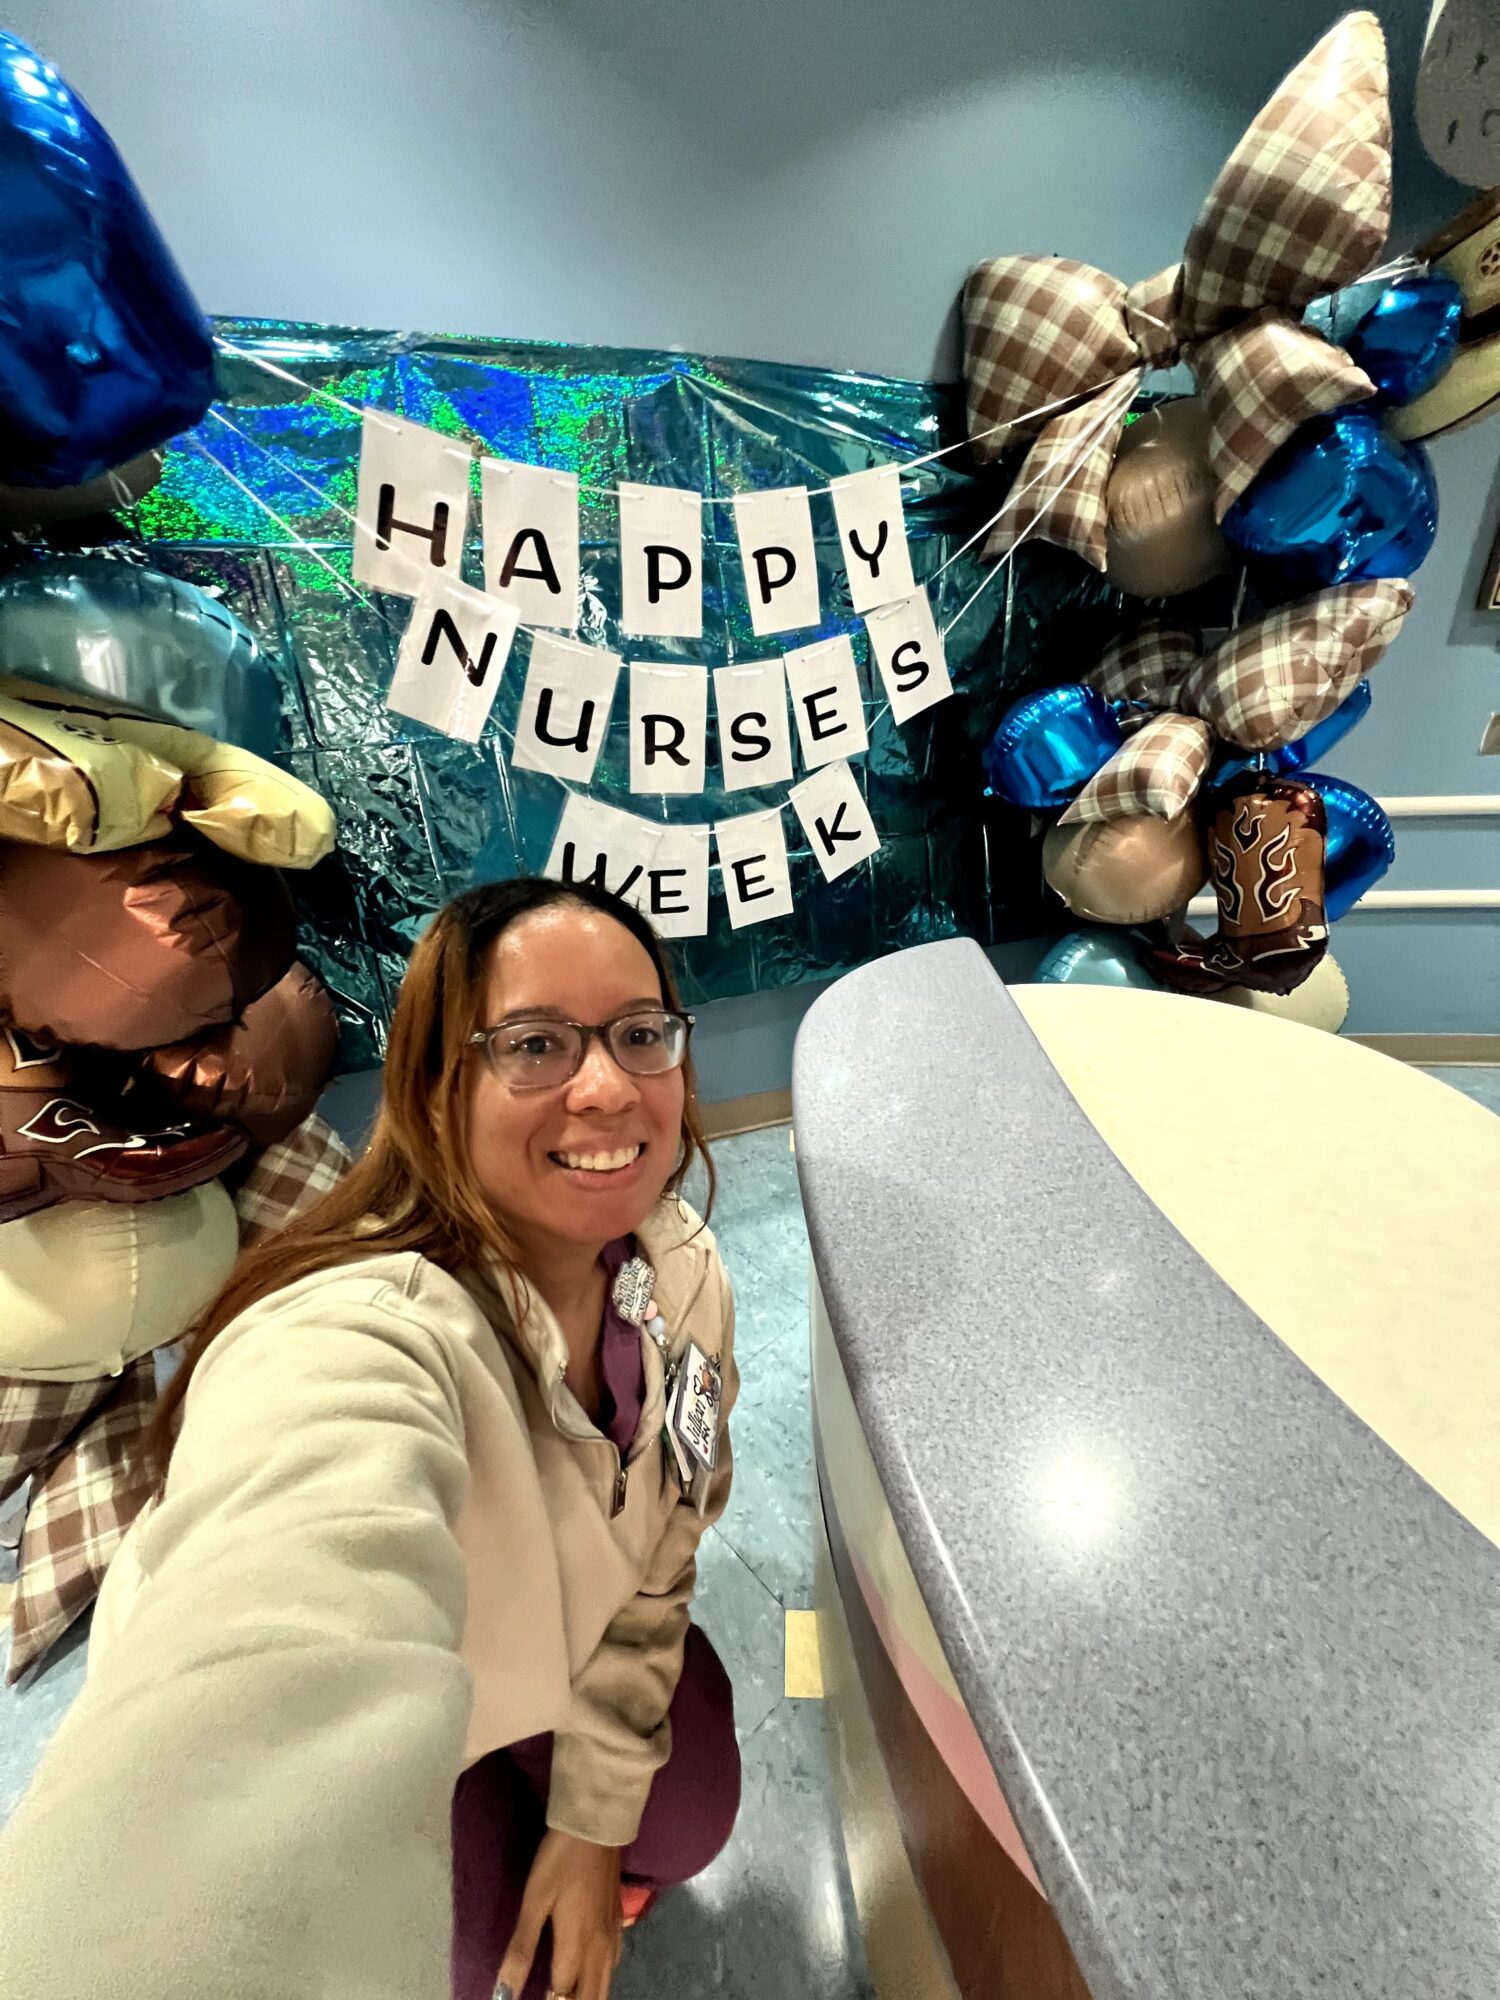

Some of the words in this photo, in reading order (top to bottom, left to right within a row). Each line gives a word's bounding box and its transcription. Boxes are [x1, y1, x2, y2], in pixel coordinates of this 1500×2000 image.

[376, 484, 888, 604] HAPPY
[421, 609, 929, 766] NURSES
[687, 1399, 706, 1445] Jillian
[701, 1421, 711, 1445] RN
